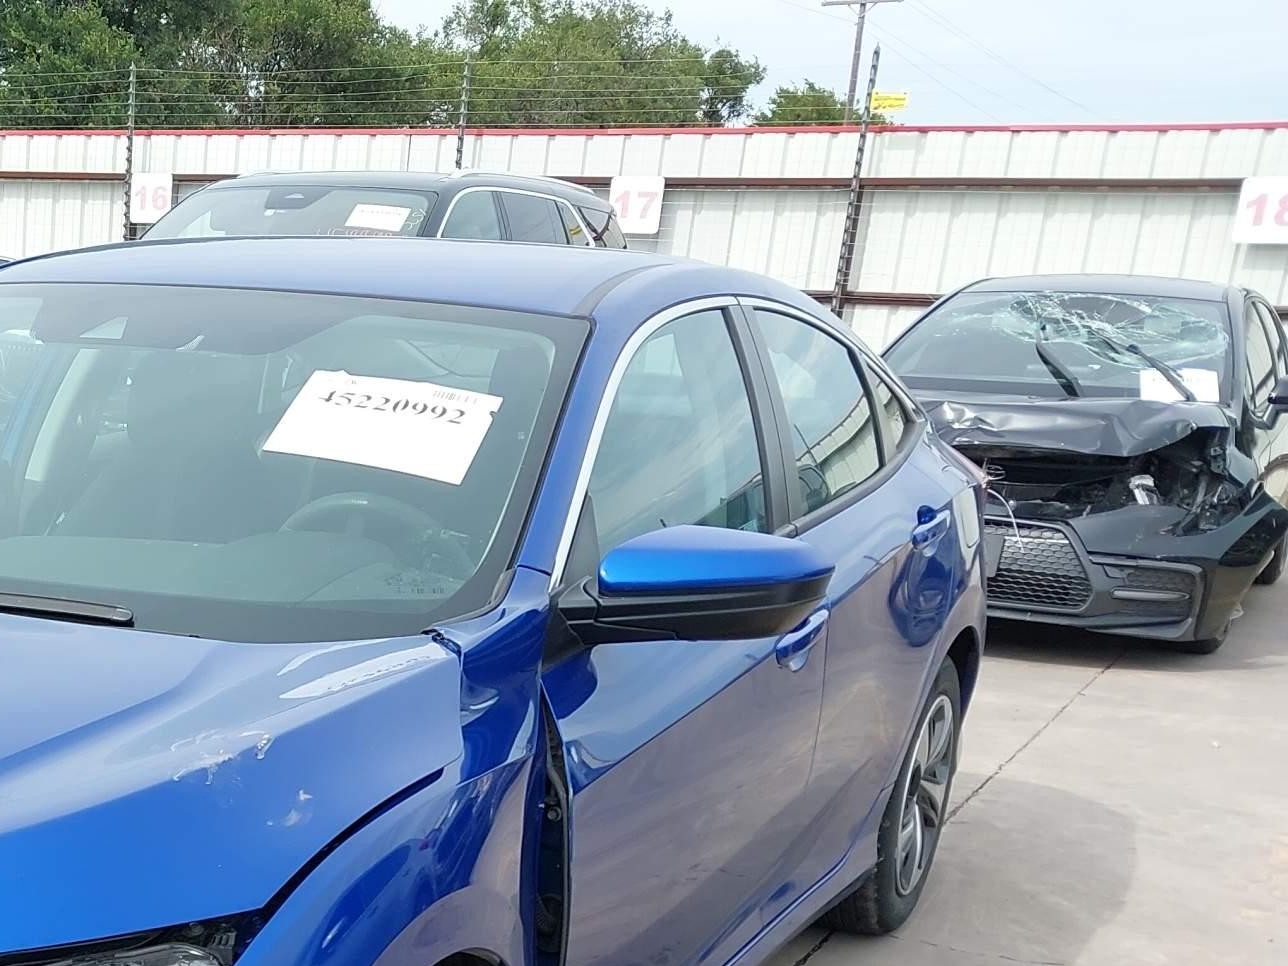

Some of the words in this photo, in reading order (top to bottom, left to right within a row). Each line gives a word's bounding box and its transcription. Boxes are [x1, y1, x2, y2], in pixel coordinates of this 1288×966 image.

[135, 186, 168, 210] 16
[615, 190, 659, 219] 17
[318, 390, 466, 424] 45220992
